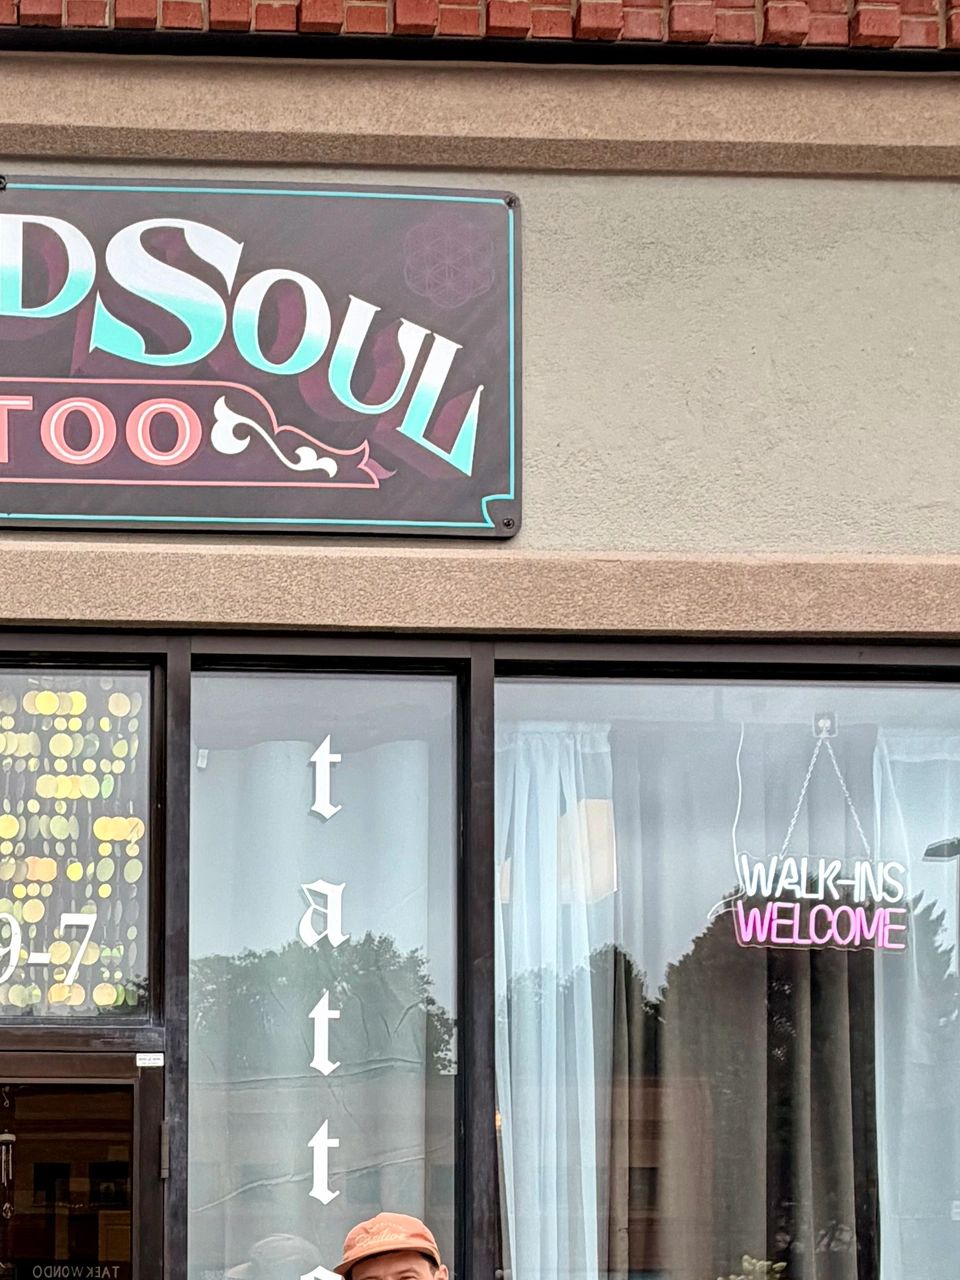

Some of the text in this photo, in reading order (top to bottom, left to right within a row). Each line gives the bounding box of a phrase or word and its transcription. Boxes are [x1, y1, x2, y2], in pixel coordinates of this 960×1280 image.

[88, 217, 485, 478] SOUL
[741, 854, 906, 903] WALK-INS
[736, 899, 907, 950] WELCOME
